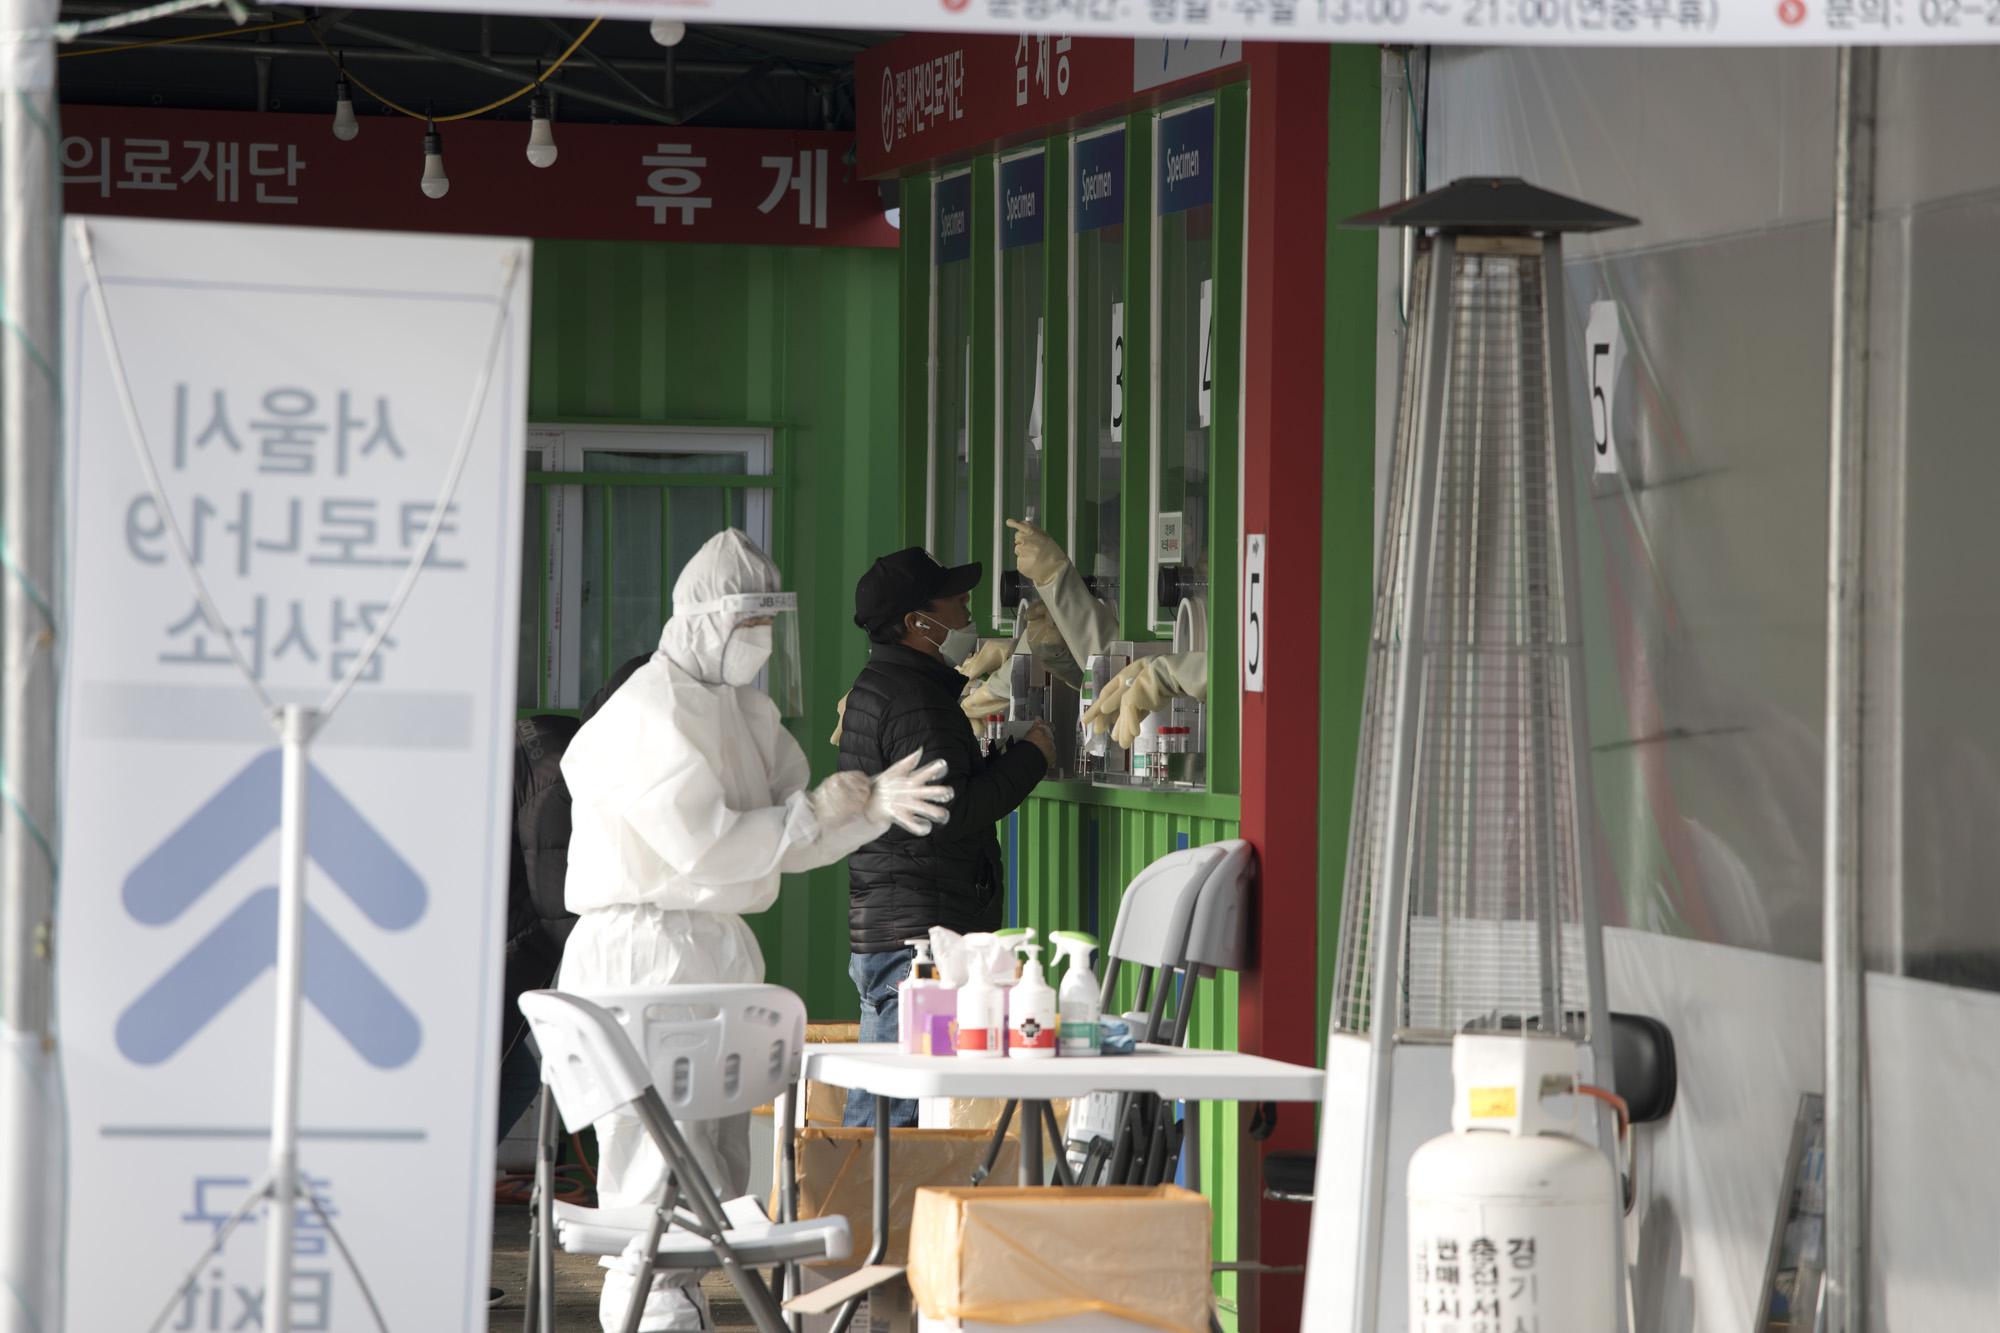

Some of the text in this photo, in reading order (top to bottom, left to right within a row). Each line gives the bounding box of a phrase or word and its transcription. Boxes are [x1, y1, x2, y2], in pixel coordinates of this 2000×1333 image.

[907, 49, 965, 135] 씨젠의료재단
[1081, 166, 1112, 211] Specimen
[1166, 145, 1200, 192] Specimen
[940, 204, 966, 246] Specimen
[1006, 186, 1036, 230] Specimen
[1112, 335, 1124, 428] 3
[1592, 343, 1611, 456] 5
[1249, 572, 1261, 676] 5
